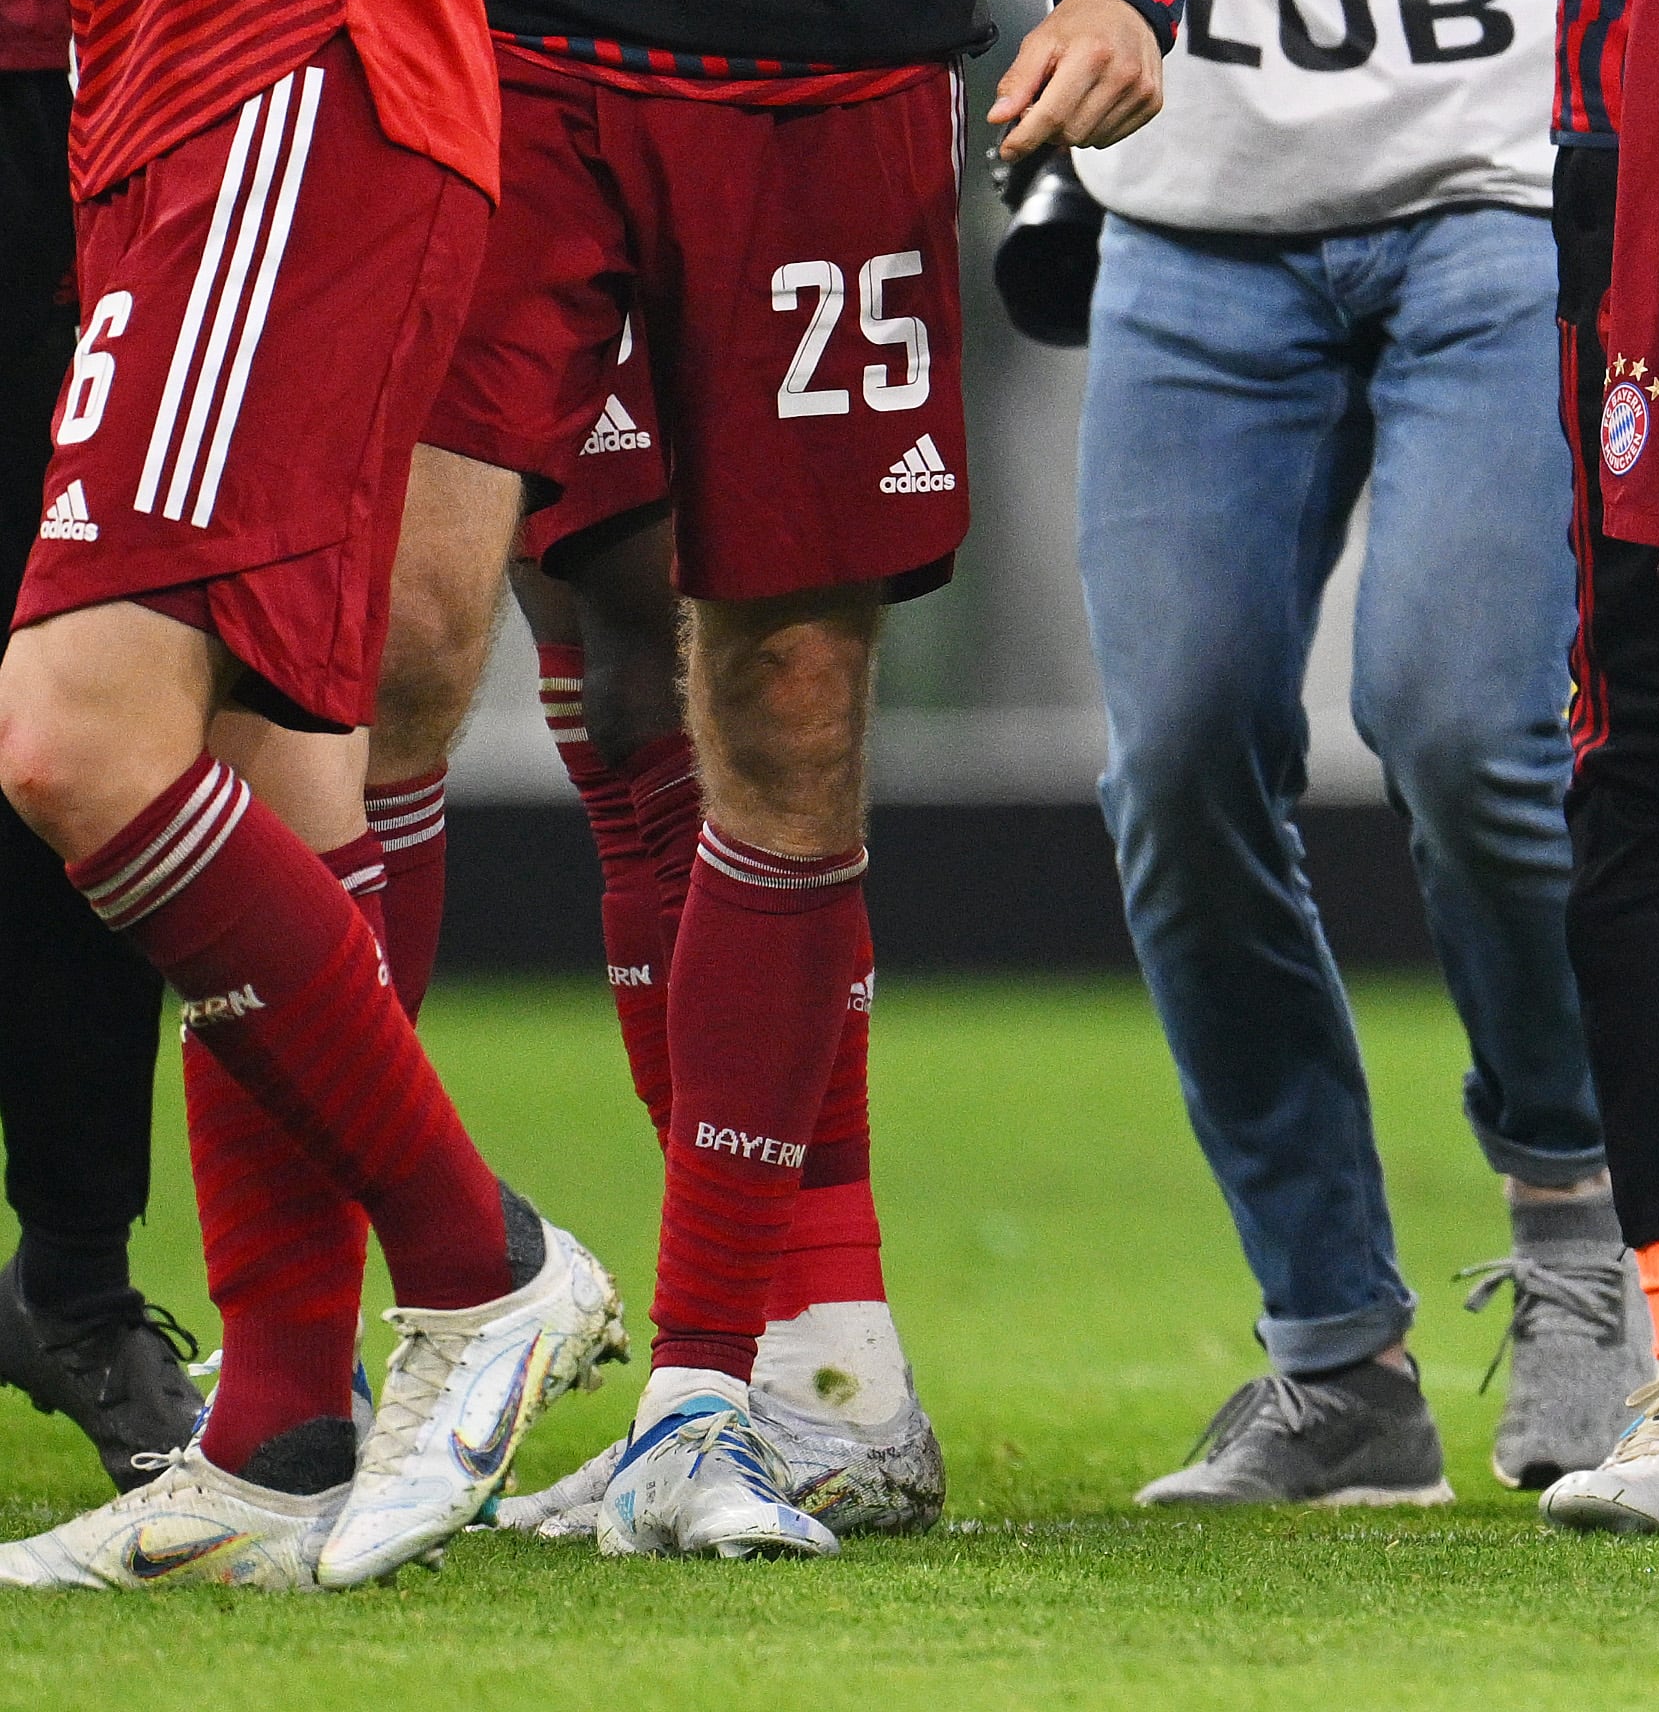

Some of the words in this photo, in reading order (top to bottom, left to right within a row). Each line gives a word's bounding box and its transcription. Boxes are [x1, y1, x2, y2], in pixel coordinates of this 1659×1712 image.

[771, 250, 931, 419] 25
[57, 290, 133, 446] 6
[1611, 388, 1643, 418] BAYERN
[879, 470, 955, 494] adidas
[695, 1121, 807, 1169] BAYERN
